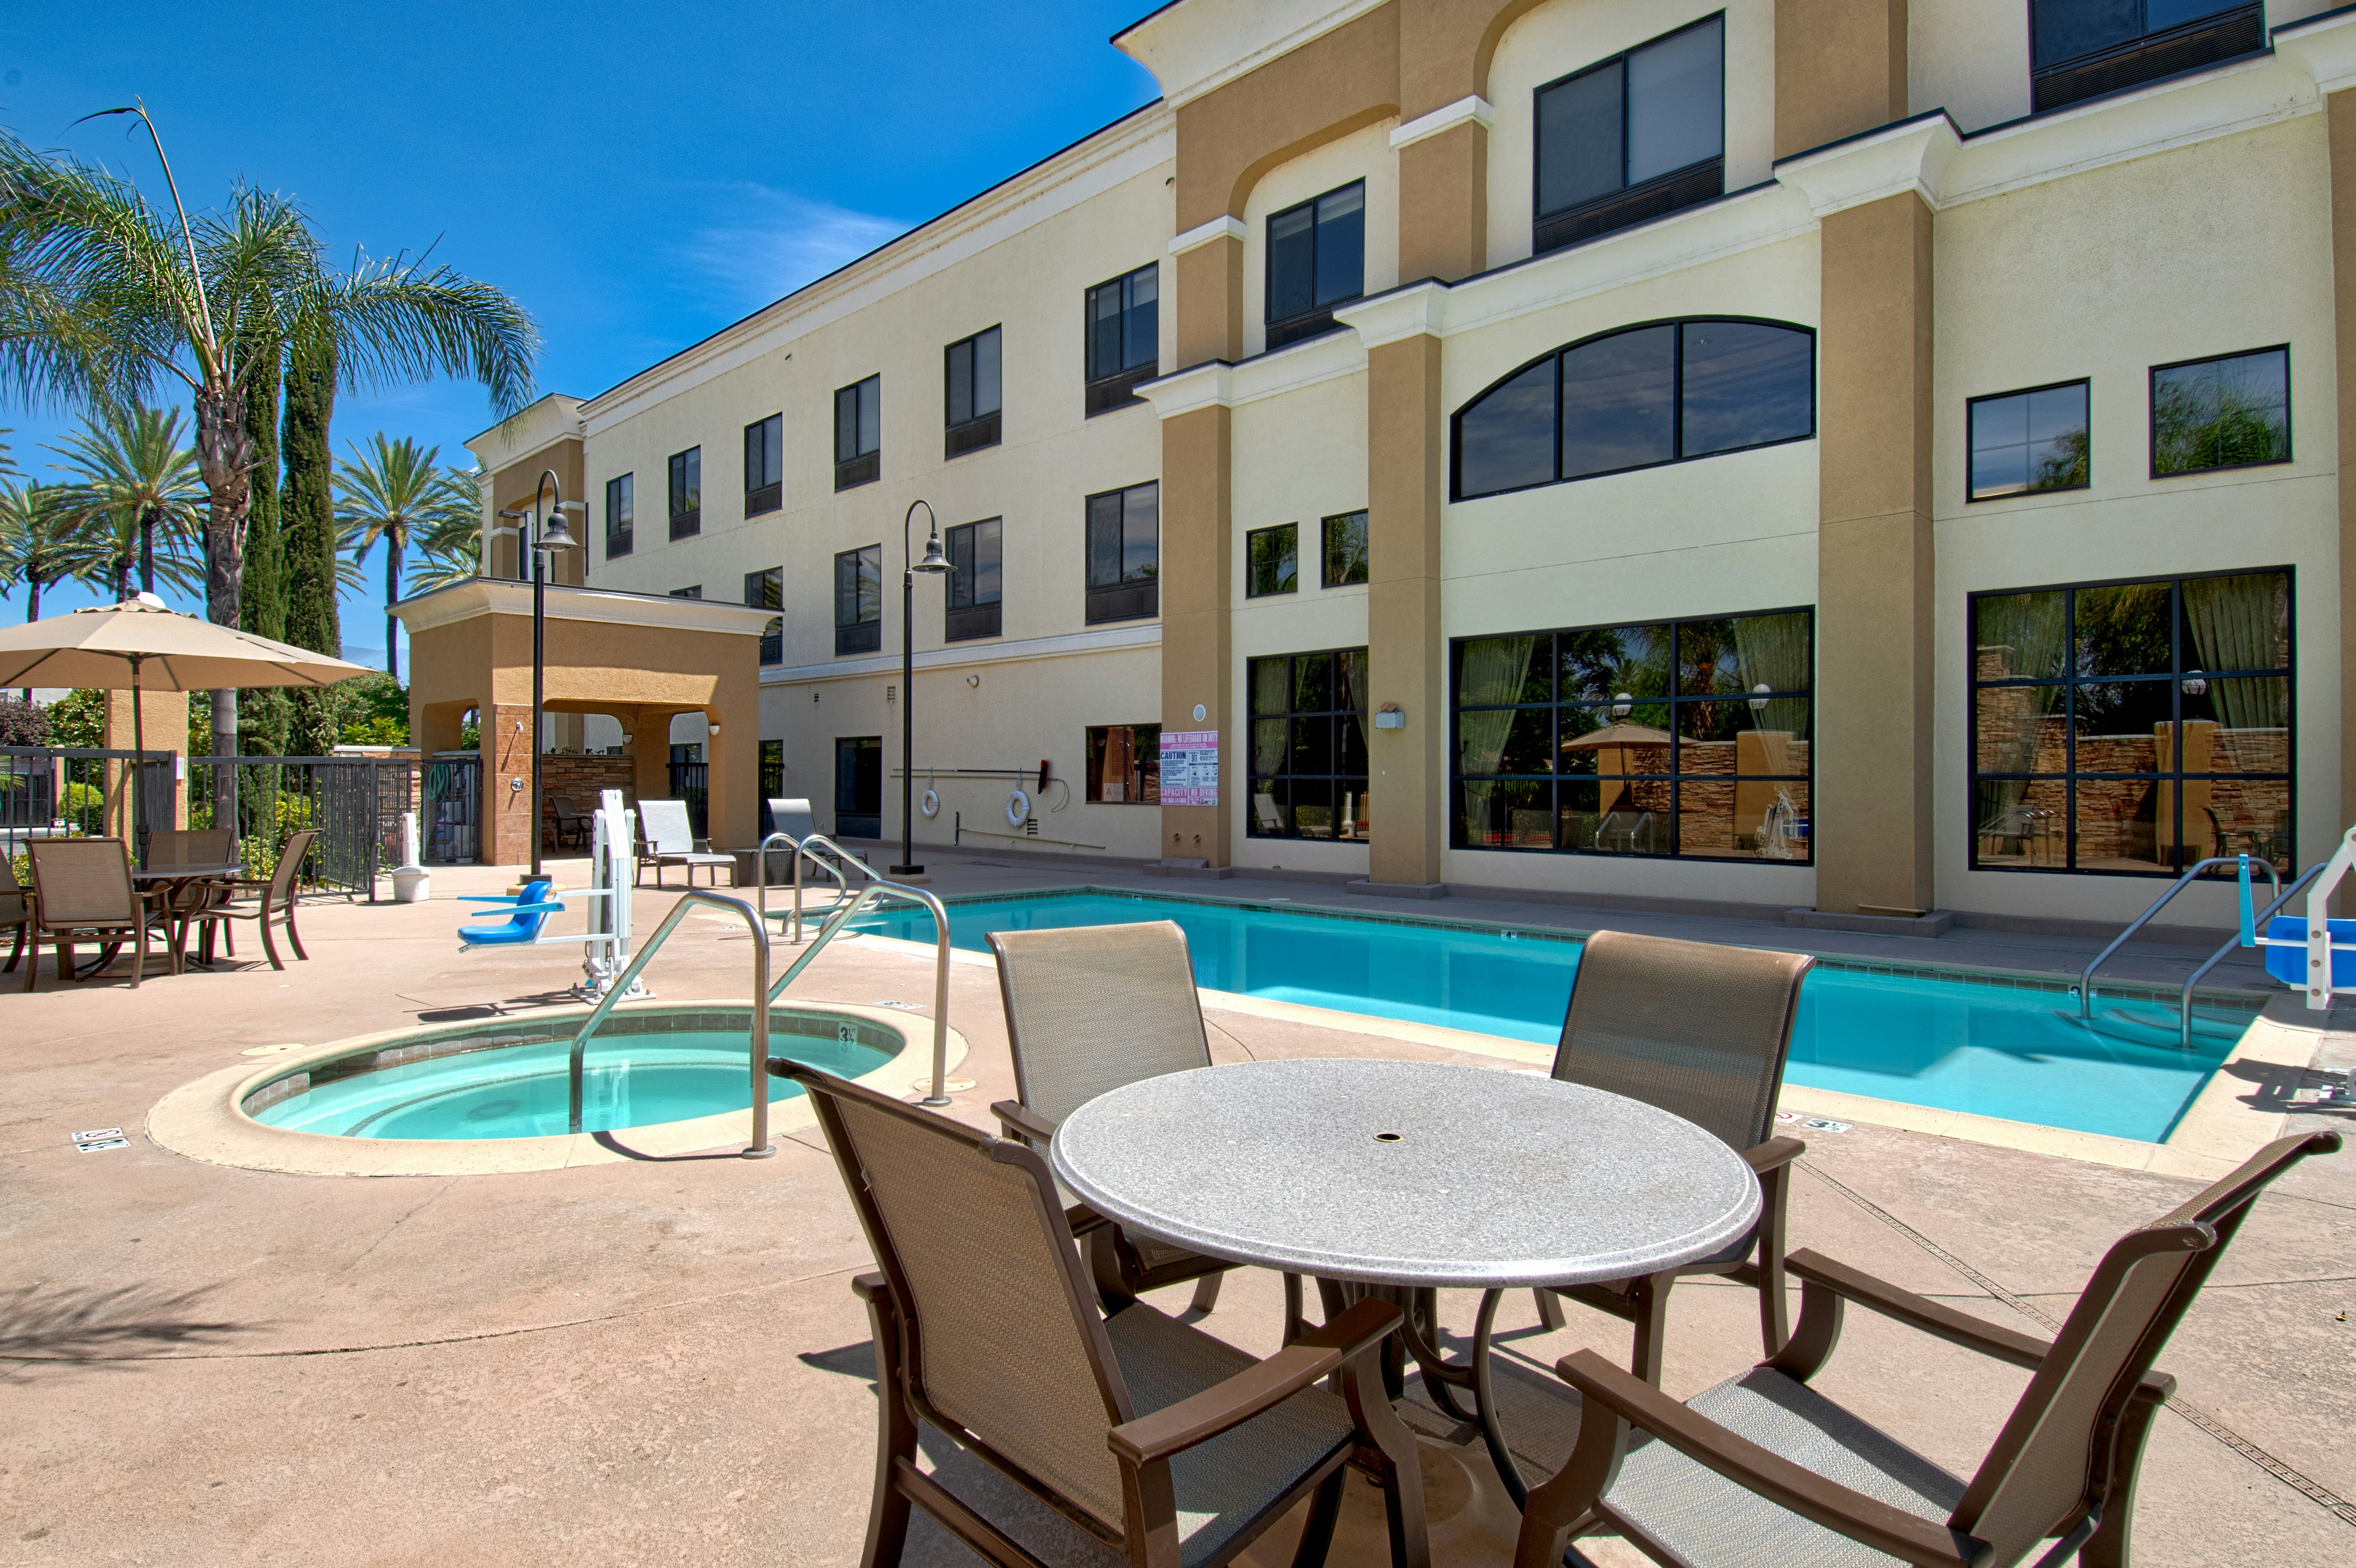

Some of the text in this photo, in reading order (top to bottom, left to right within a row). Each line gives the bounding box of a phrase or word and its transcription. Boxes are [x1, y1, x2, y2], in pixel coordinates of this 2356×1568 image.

[1160, 733, 1218, 743] WARNING: NO LIFEGUARD ON DUTY
[1106, 787, 1112, 796] A
[1191, 788, 1217, 796] NO DIVING
